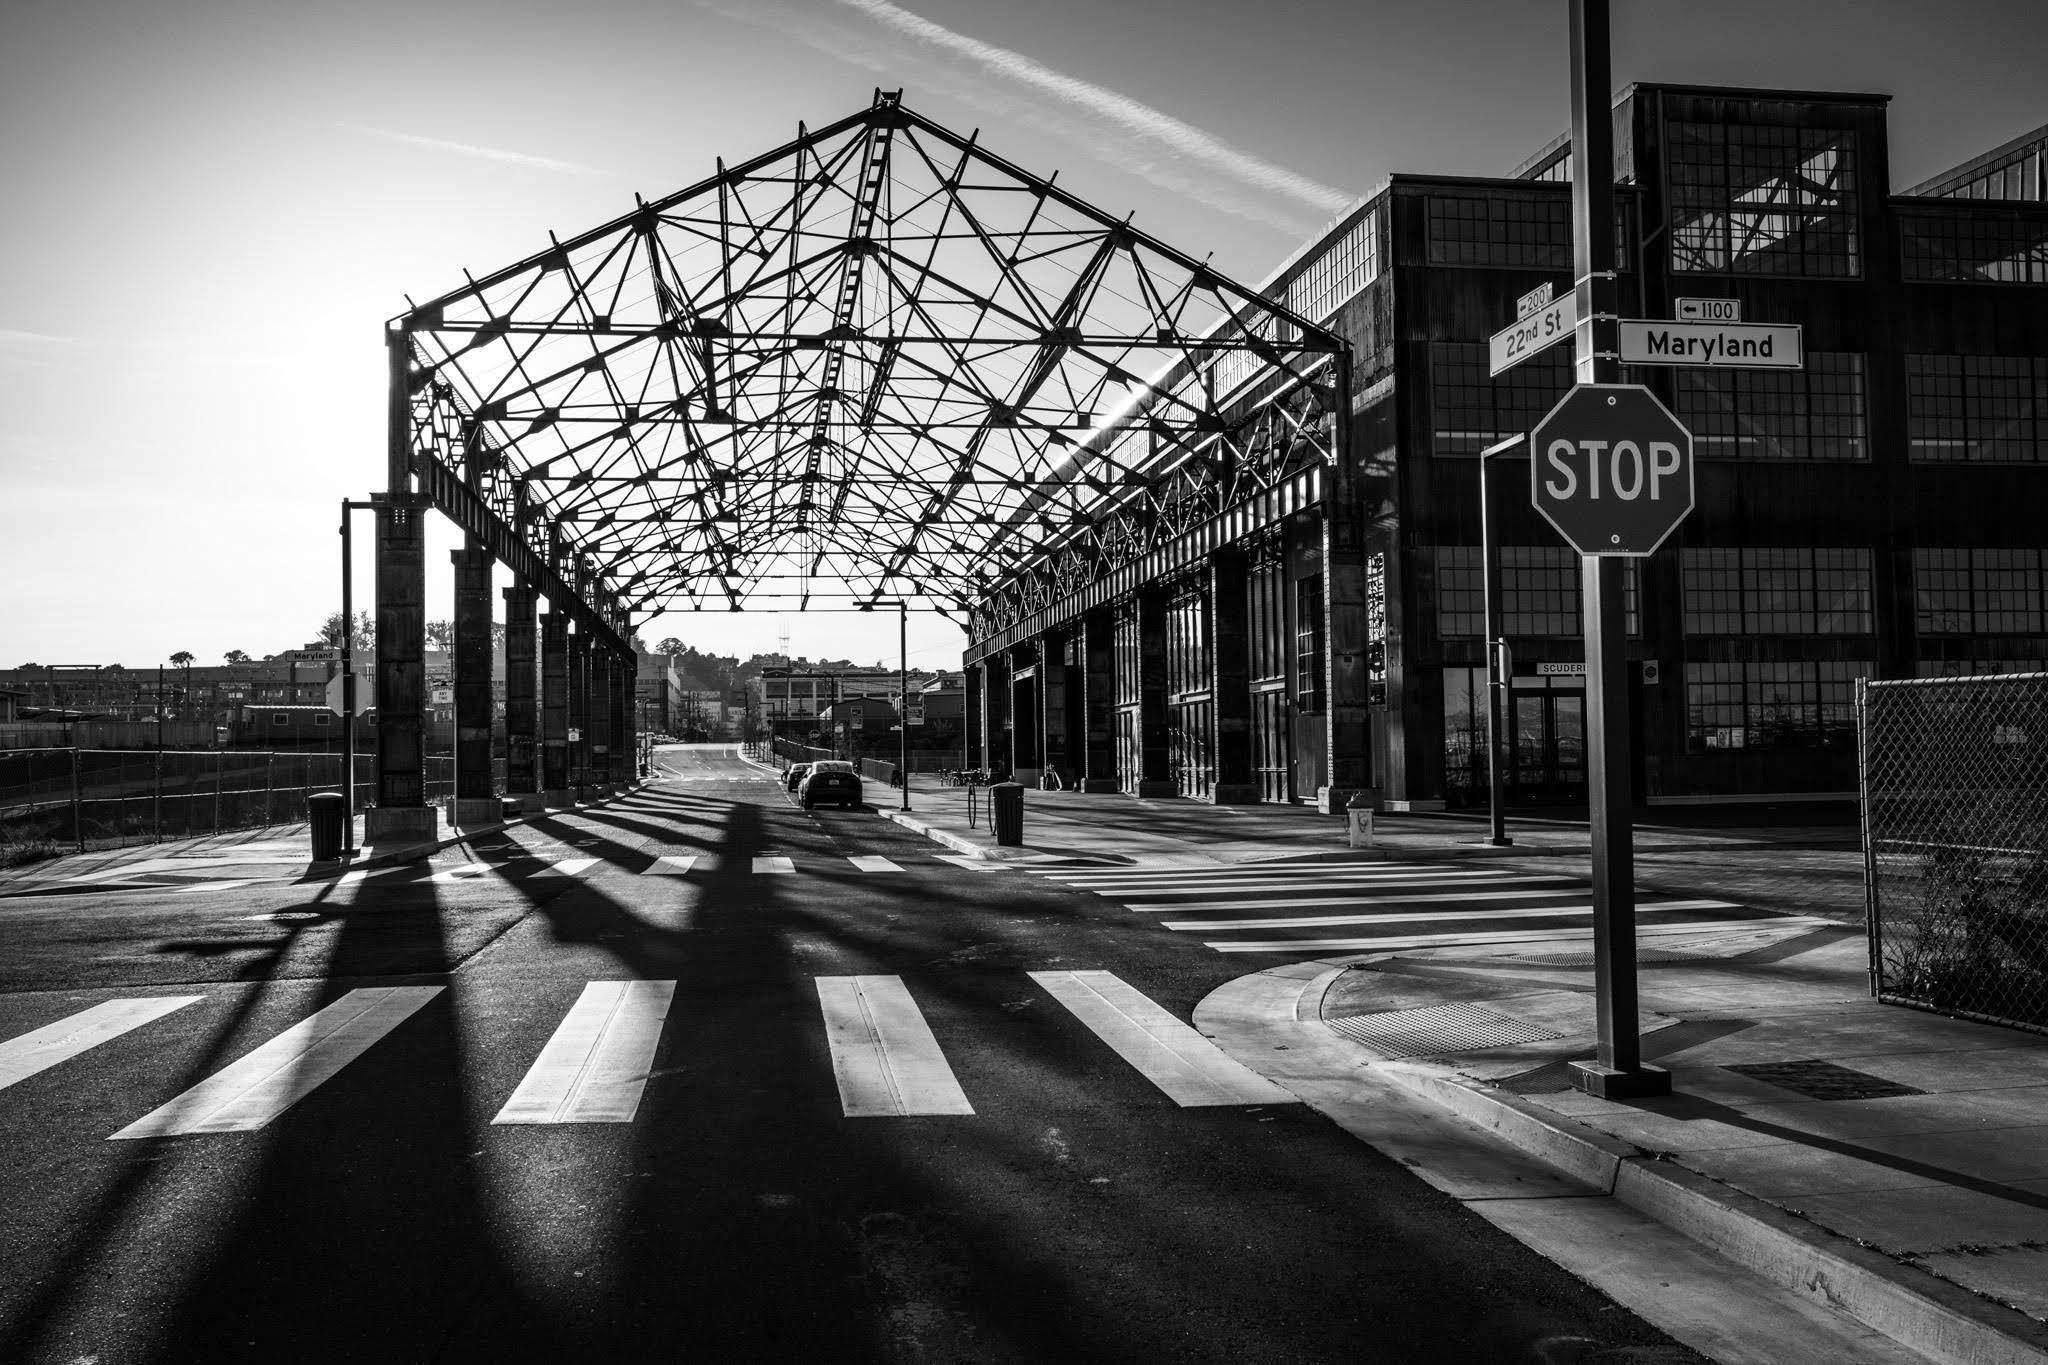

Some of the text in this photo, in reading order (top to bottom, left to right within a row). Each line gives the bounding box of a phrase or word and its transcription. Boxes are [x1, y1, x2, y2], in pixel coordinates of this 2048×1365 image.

[1527, 289, 1545, 312] 200
[1701, 301, 1733, 319] 1100
[1506, 308, 1561, 358] 22nd St
[1647, 330, 1773, 362] Maryland
[1545, 438, 1681, 501] STOP
[294, 651, 333, 661] Maryland
